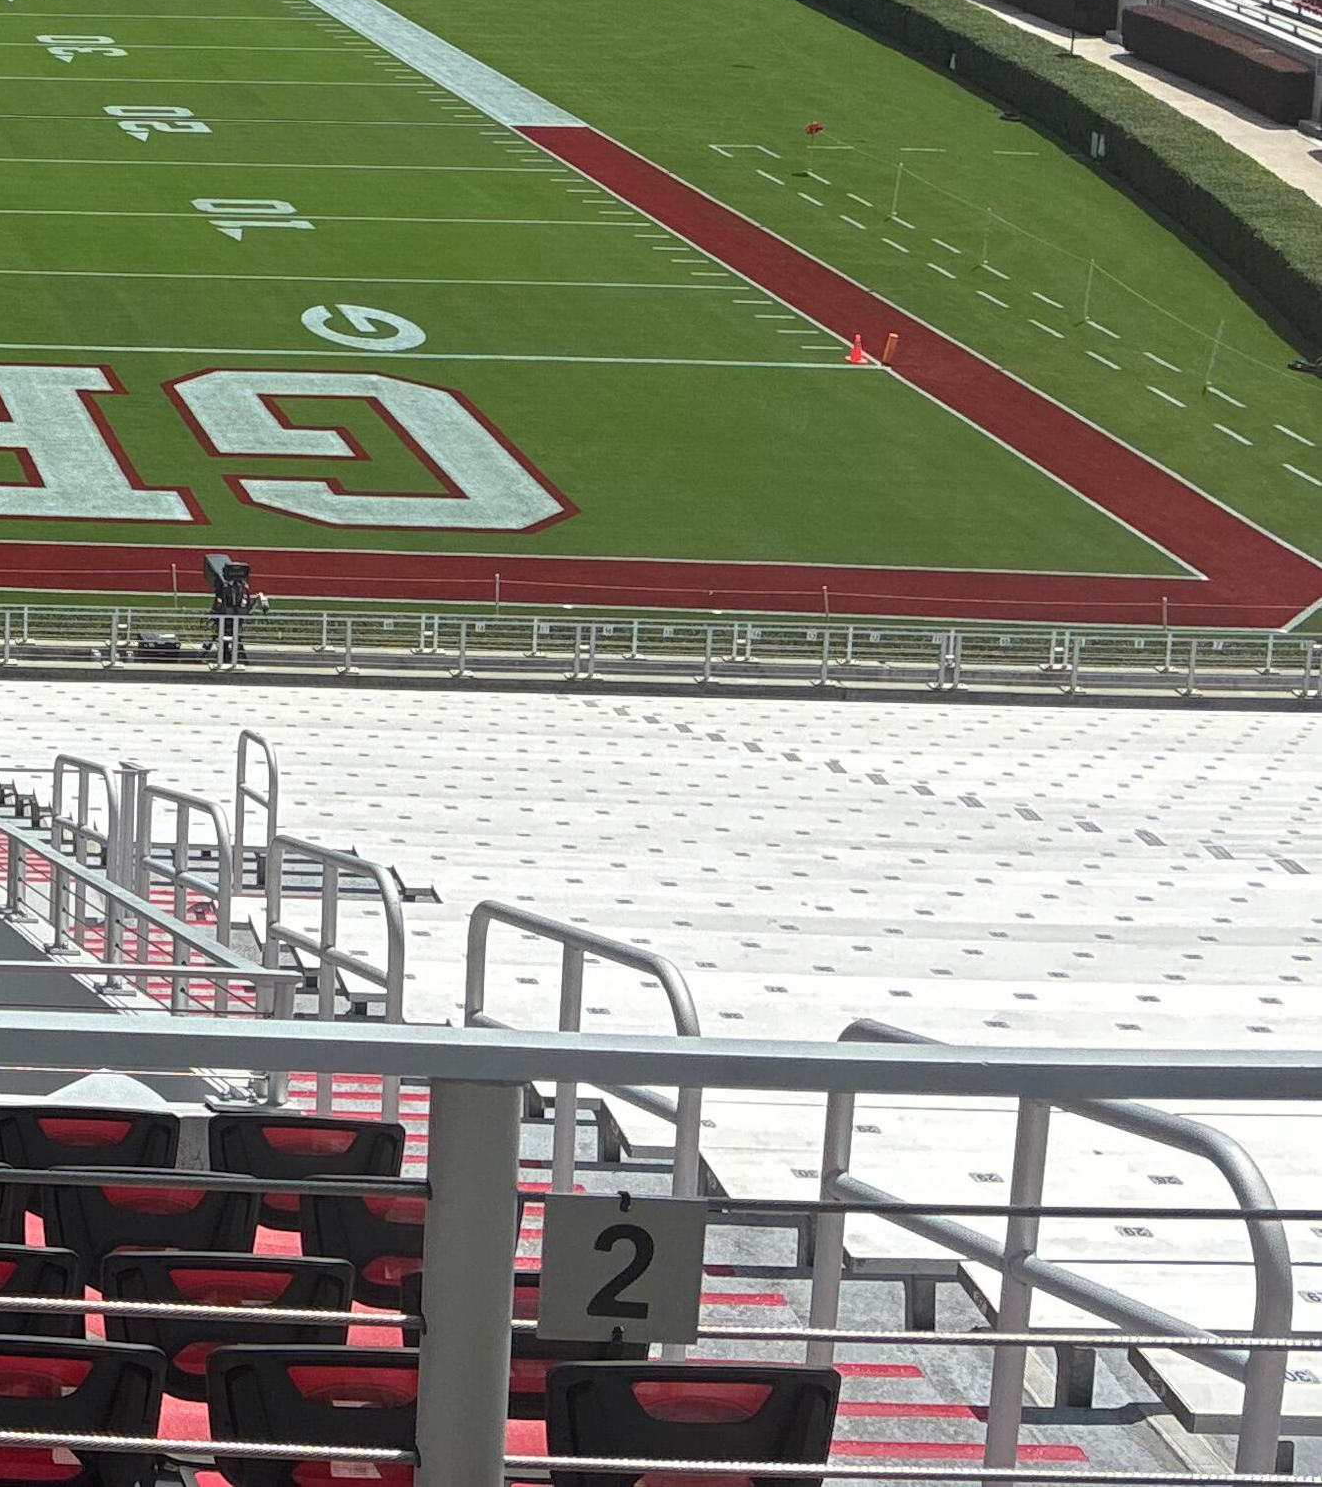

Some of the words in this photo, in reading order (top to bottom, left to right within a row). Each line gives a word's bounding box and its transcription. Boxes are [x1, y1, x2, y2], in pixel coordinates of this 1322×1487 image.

[103, 104, 214, 133] 20
[190, 198, 316, 231] 10
[299, 302, 427, 352] G
[586, 1223, 654, 1320] 2
